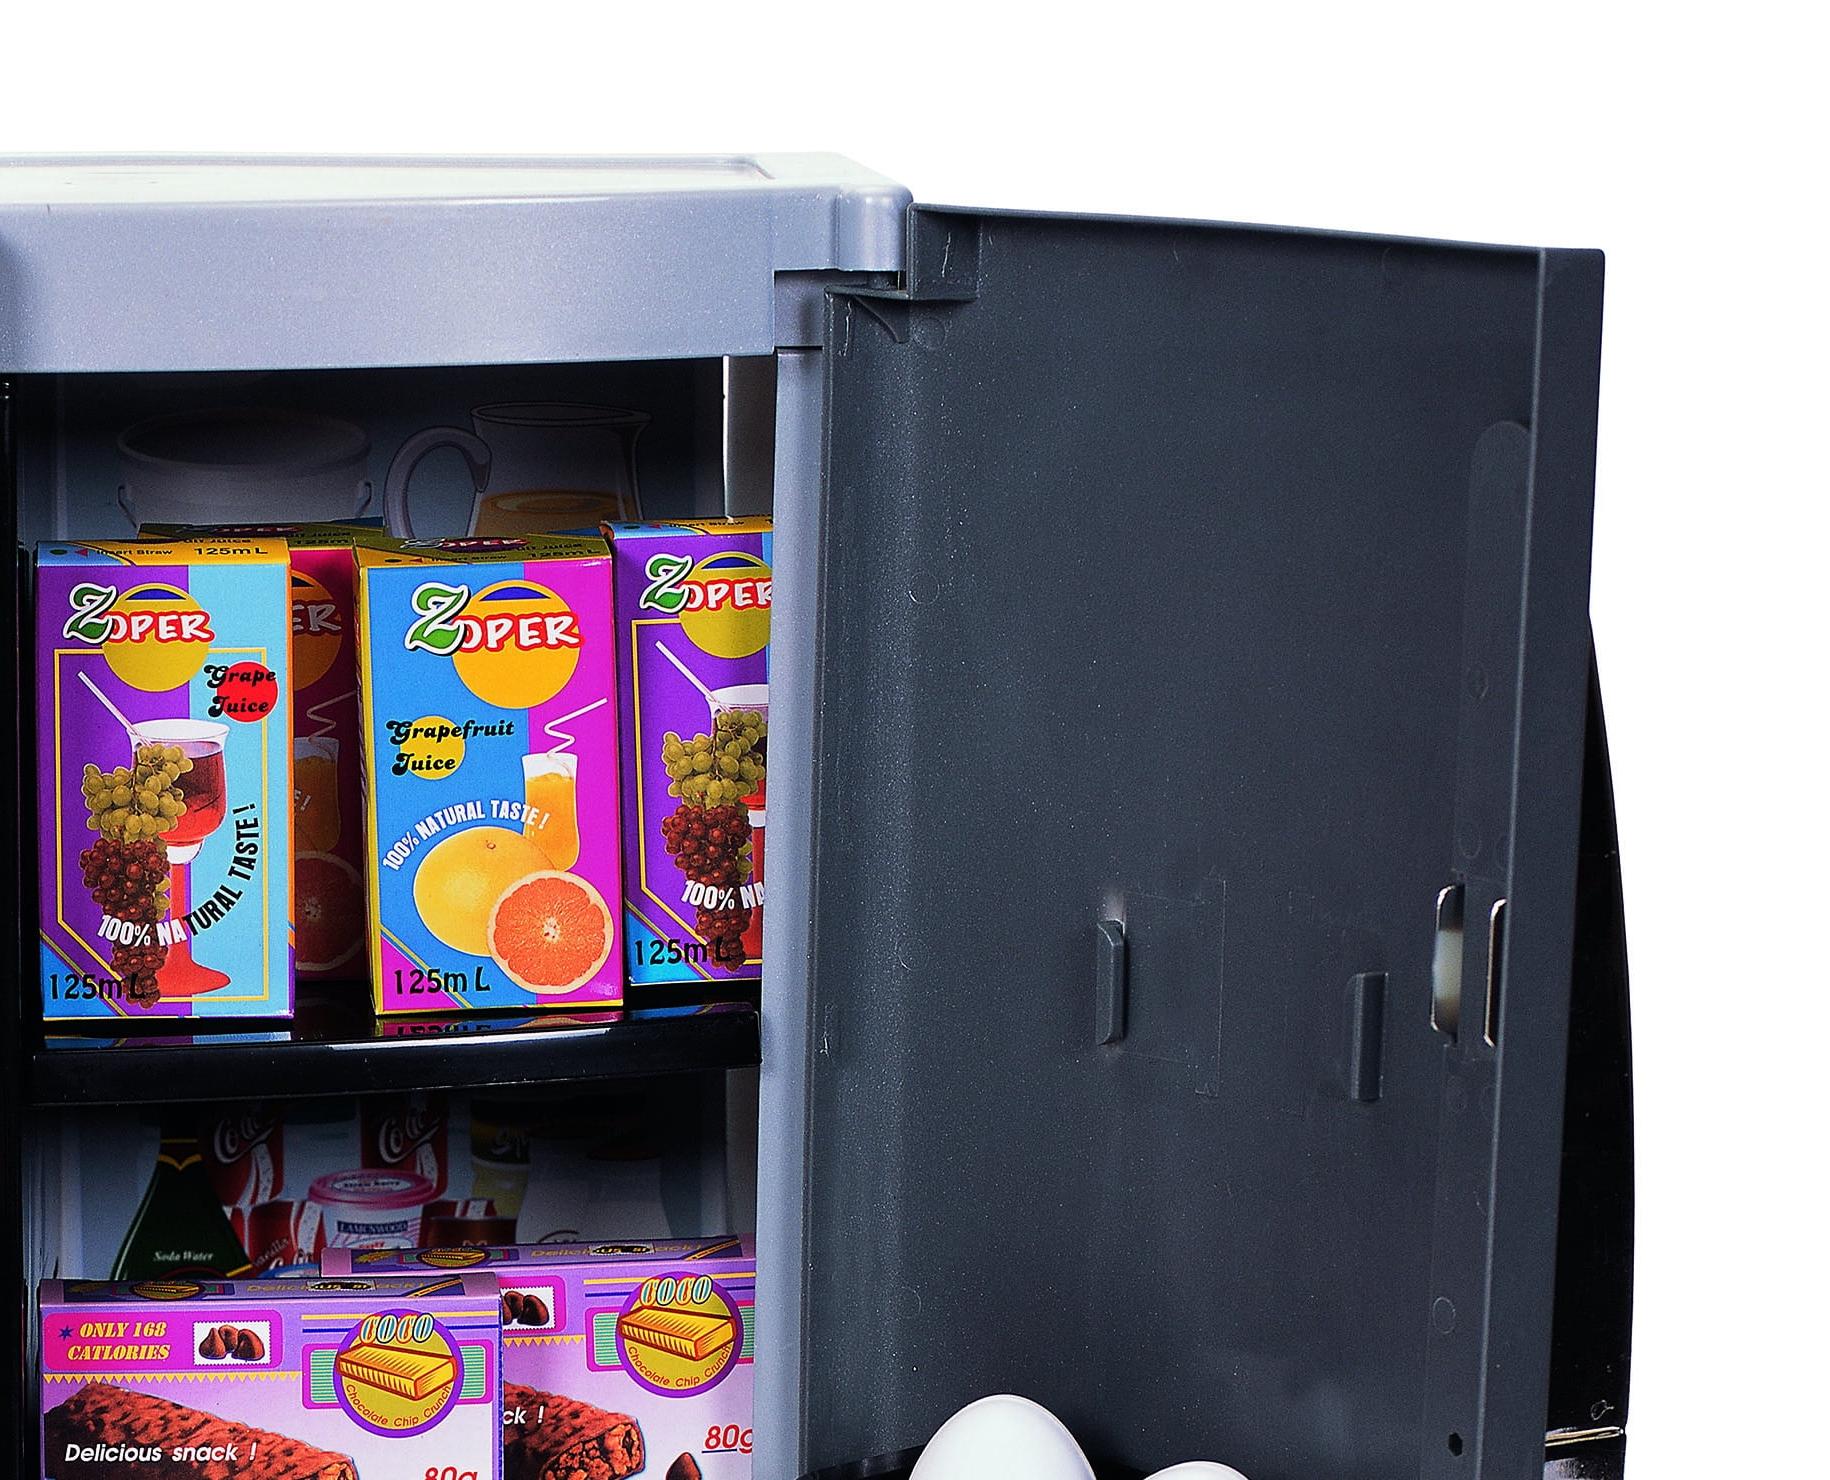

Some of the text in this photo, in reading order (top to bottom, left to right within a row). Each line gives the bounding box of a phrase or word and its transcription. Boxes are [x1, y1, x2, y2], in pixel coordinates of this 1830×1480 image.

[63, 583, 216, 645] ZOPER
[404, 581, 585, 656] ZOPER
[204, 664, 277, 688] Grape
[208, 695, 270, 718] Juice
[386, 718, 515, 745] Grapefruit
[391, 751, 457, 776] Juice
[382, 831, 420, 871] 100%
[414, 800, 486, 841] NATURAL
[681, 880, 735, 911] 100%
[98, 914, 151, 947] 100%
[156, 884, 244, 947] NATURAL
[183, 1250, 214, 1262] Water
[640, 1275, 714, 1308] COCO
[79, 1321, 168, 1338] ONLY 168
[359, 1312, 435, 1345] COCO
[67, 1344, 171, 1361] CATLORIES
[628, 1345, 732, 1388] Chocolate Chip Crunch
[346, 1383, 452, 1427] Chocolate Chip Crunch
[65, 1443, 163, 1463] Delicious
[171, 1443, 238, 1462] snack
